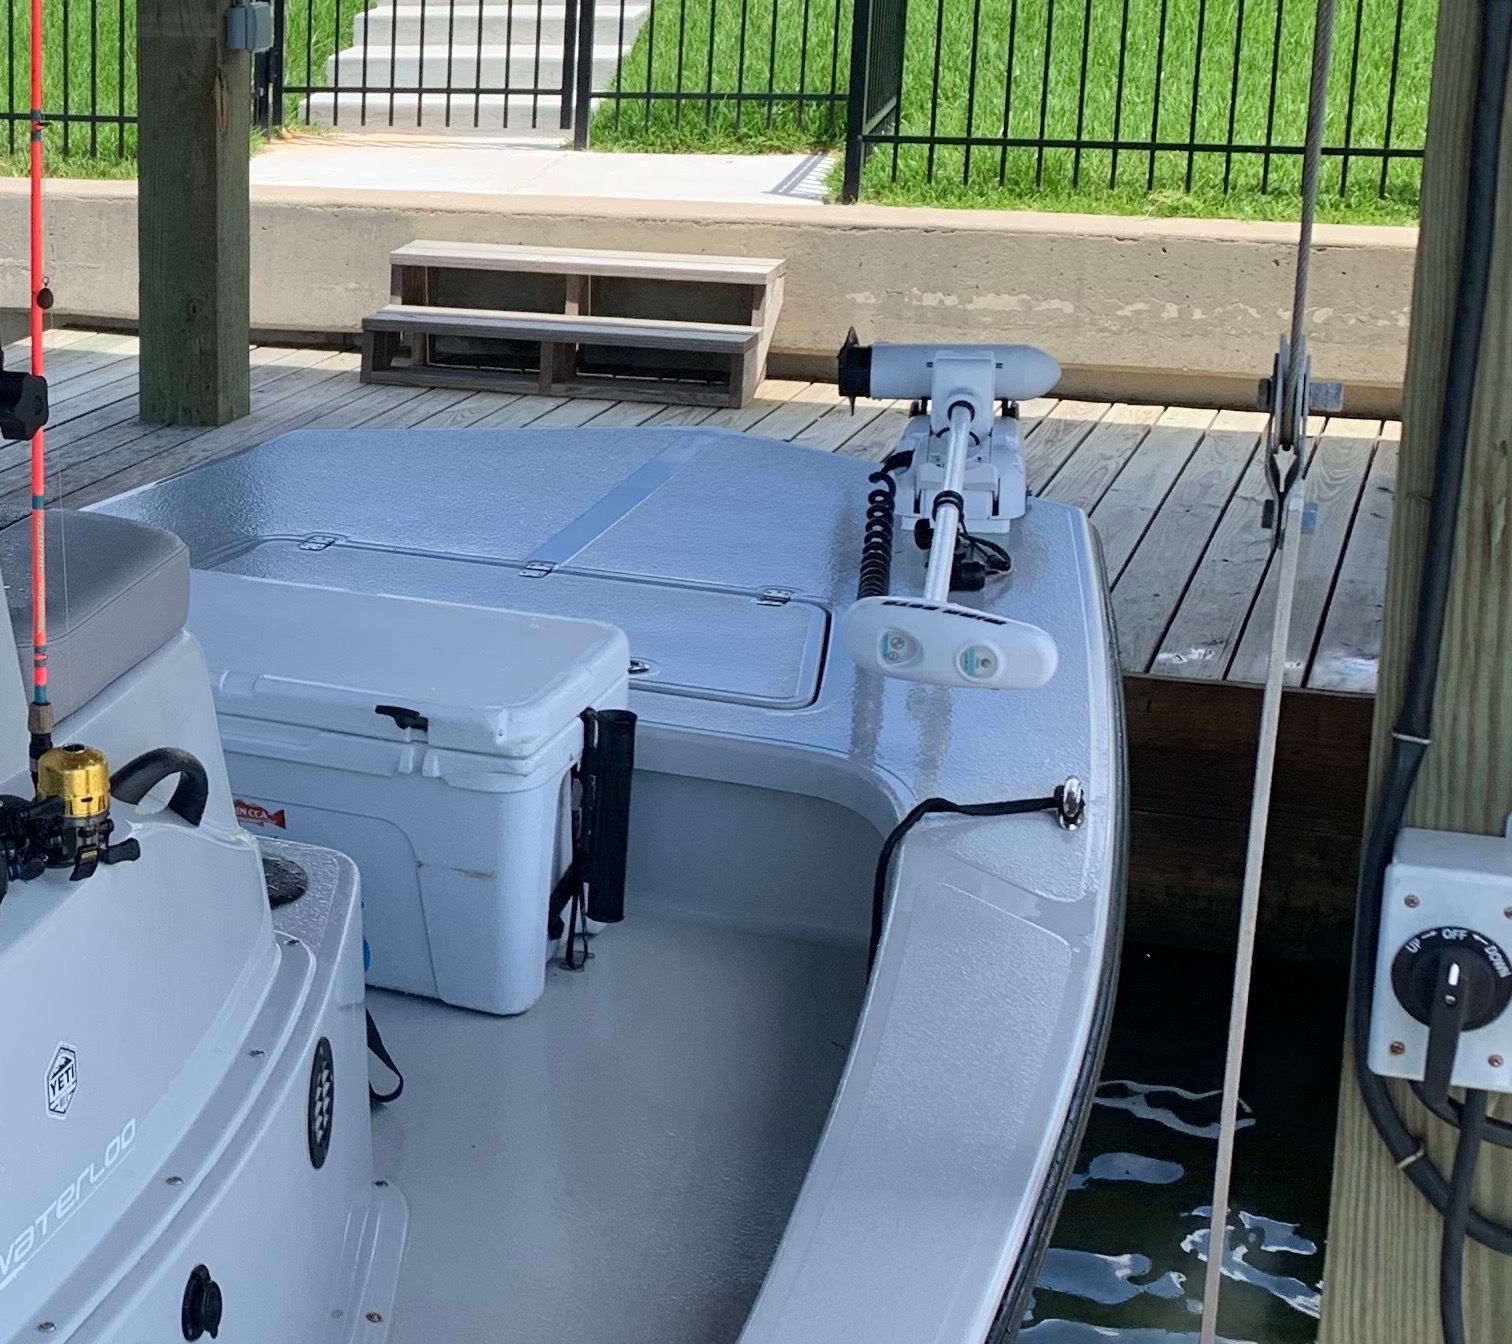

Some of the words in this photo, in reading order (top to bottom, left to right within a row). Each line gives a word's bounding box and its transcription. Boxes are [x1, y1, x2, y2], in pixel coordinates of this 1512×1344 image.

[248, 808, 268, 820] CCA
[1405, 938, 1422, 954] UP
[1442, 928, 1468, 940] OFF
[1484, 945, 1512, 978] DOWN
[50, 1064, 75, 1096] YETI
